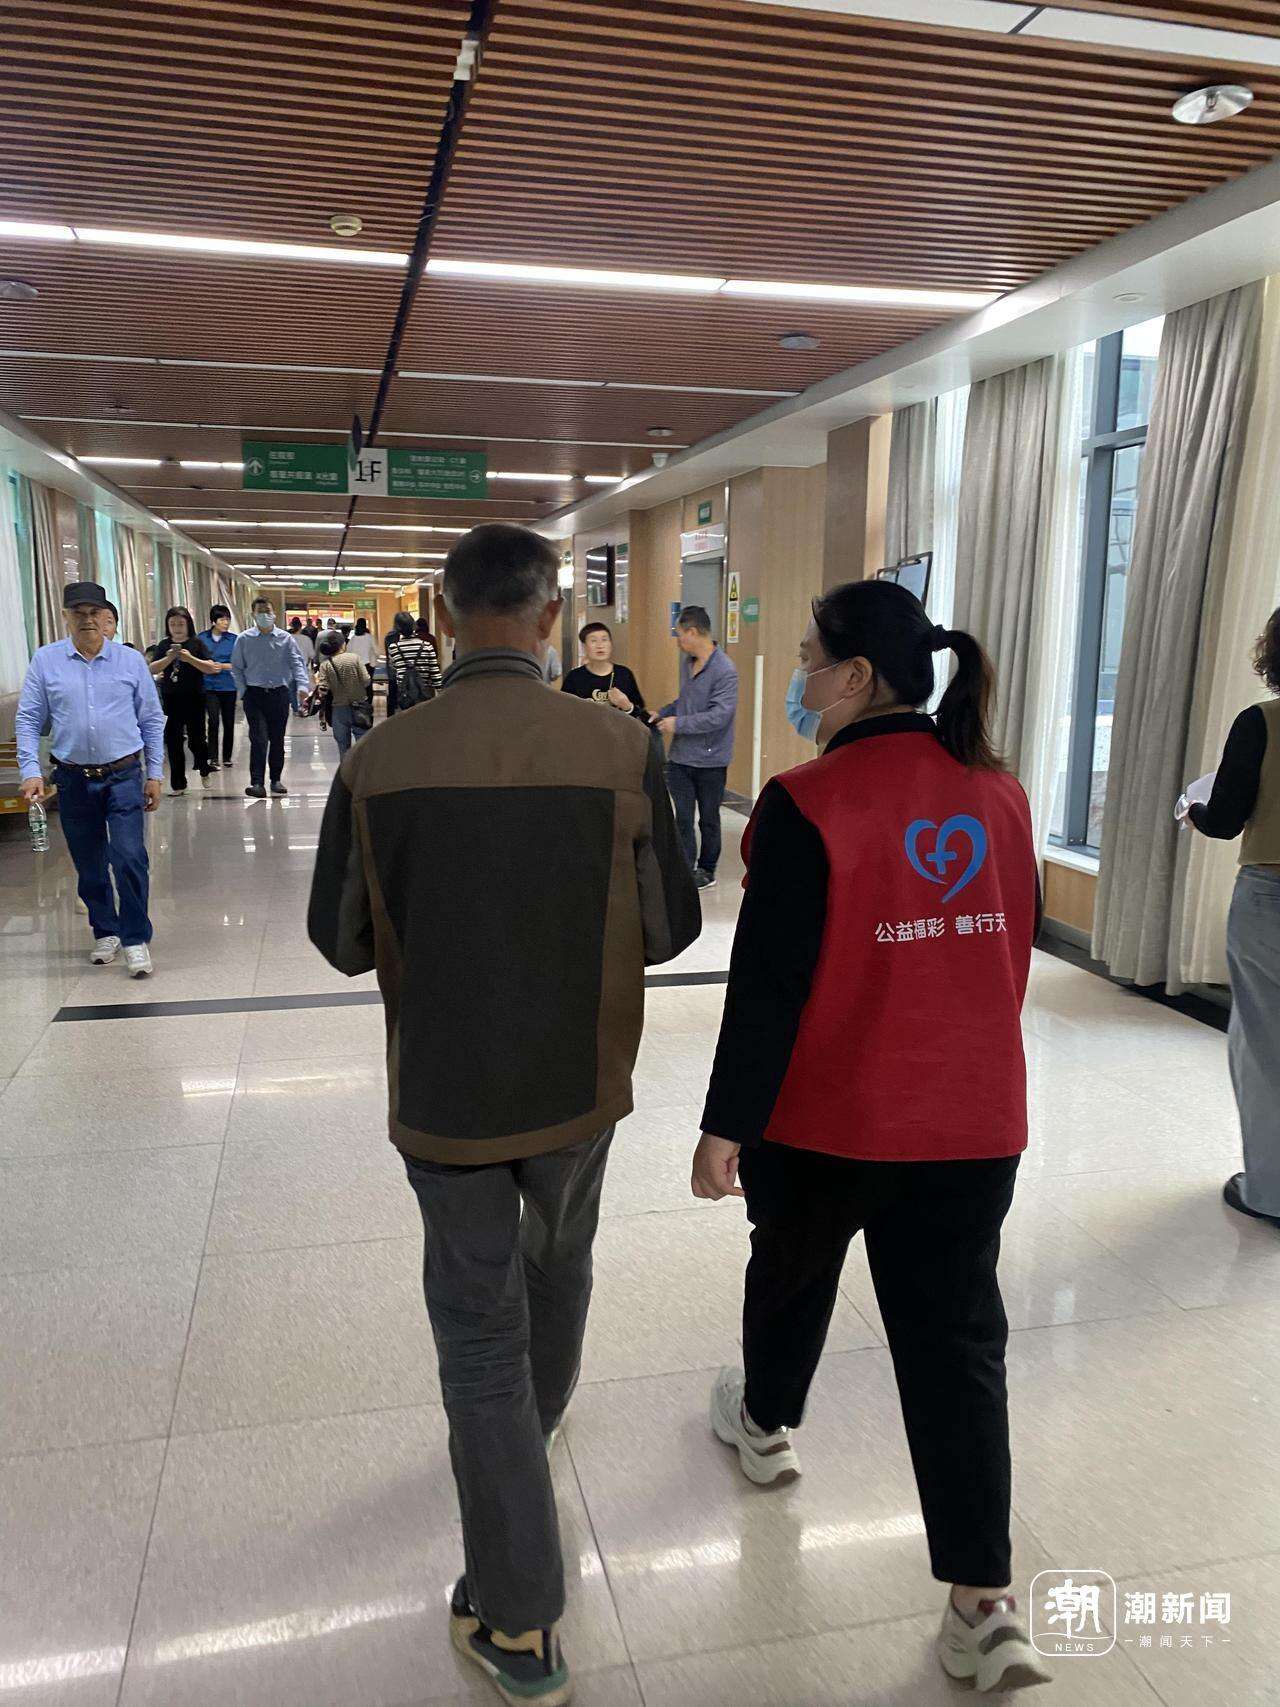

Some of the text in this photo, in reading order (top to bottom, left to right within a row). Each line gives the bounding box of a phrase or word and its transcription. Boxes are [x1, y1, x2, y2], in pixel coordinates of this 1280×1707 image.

[355, 461, 382, 482] 1F
[875, 917, 944, 943] 公益福彩
